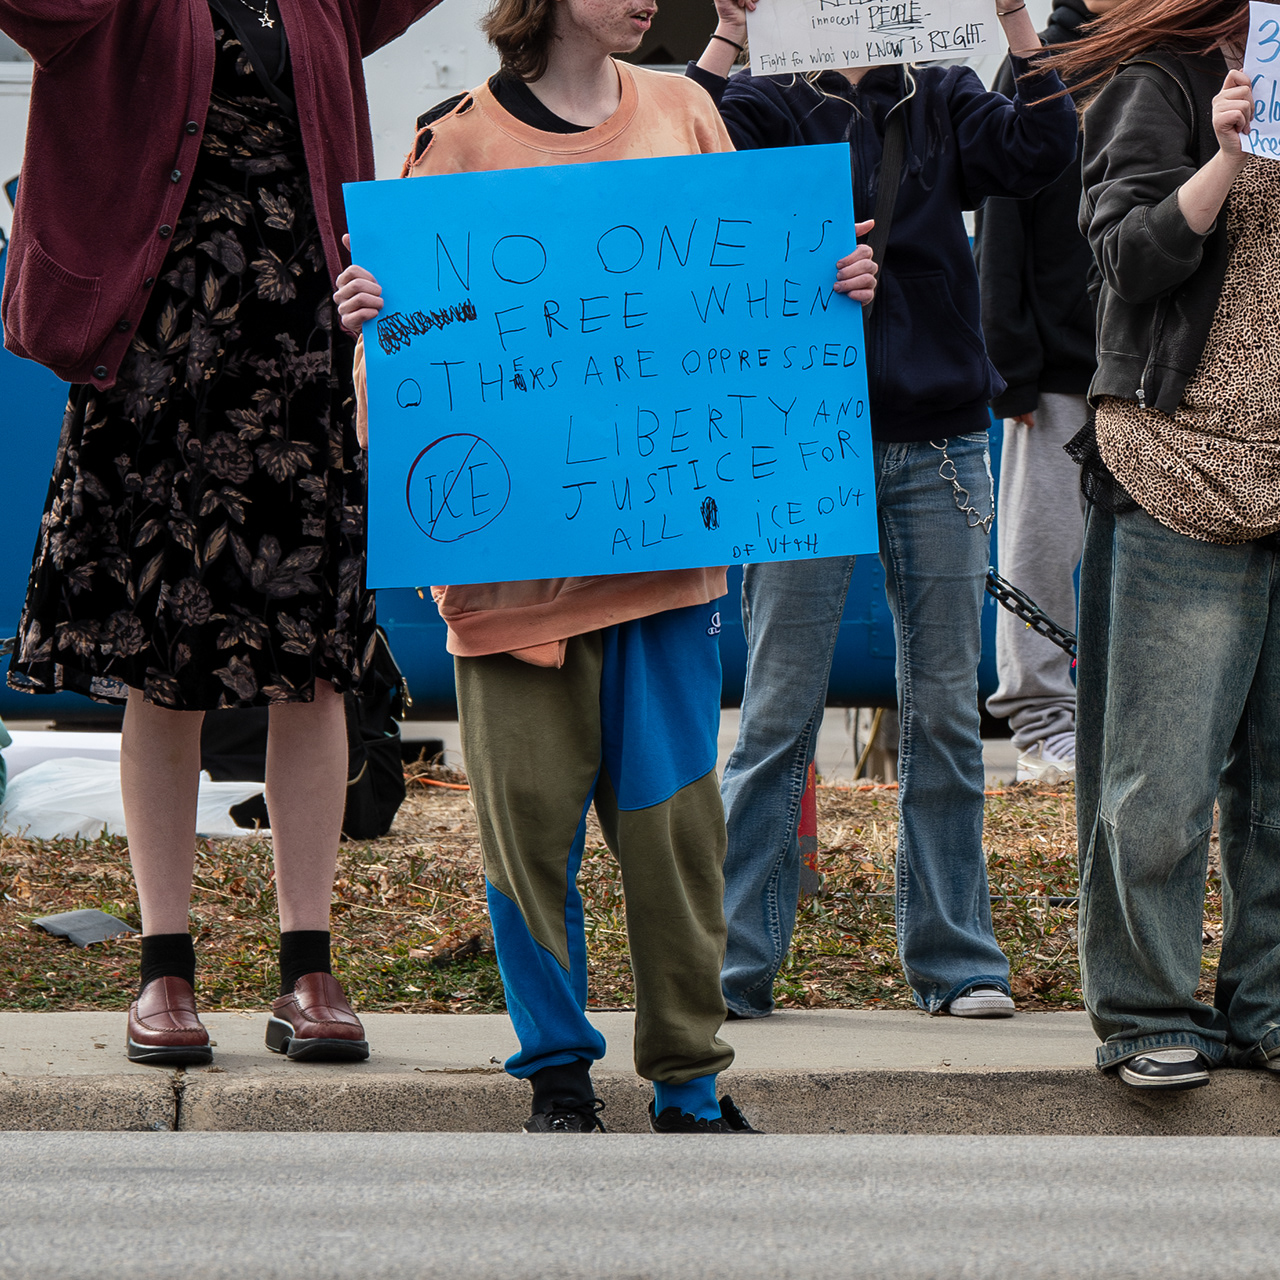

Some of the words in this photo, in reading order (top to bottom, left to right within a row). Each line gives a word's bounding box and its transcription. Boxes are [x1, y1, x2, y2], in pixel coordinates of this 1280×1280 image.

[812, 9, 861, 29] innocent
[760, 45, 786, 72] Fight
[792, 52, 803, 65] for
[810, 49, 835, 64] what
[843, 50, 859, 67] you
[866, 38, 905, 58] KNOW
[913, 39, 923, 53] is
[435, 230, 547, 292] NO
[596, 217, 752, 274] ONE
[495, 291, 649, 352] FREE
[690, 279, 836, 323] WHEN
[584, 348, 659, 388] ARE
[681, 343, 858, 376] OPPRESSED
[813, 398, 865, 428] AND
[424, 462, 490, 525] ICE
[562, 445, 777, 521] JUSTICE
[611, 520, 684, 555] ALL
[733, 544, 756, 558] OF
